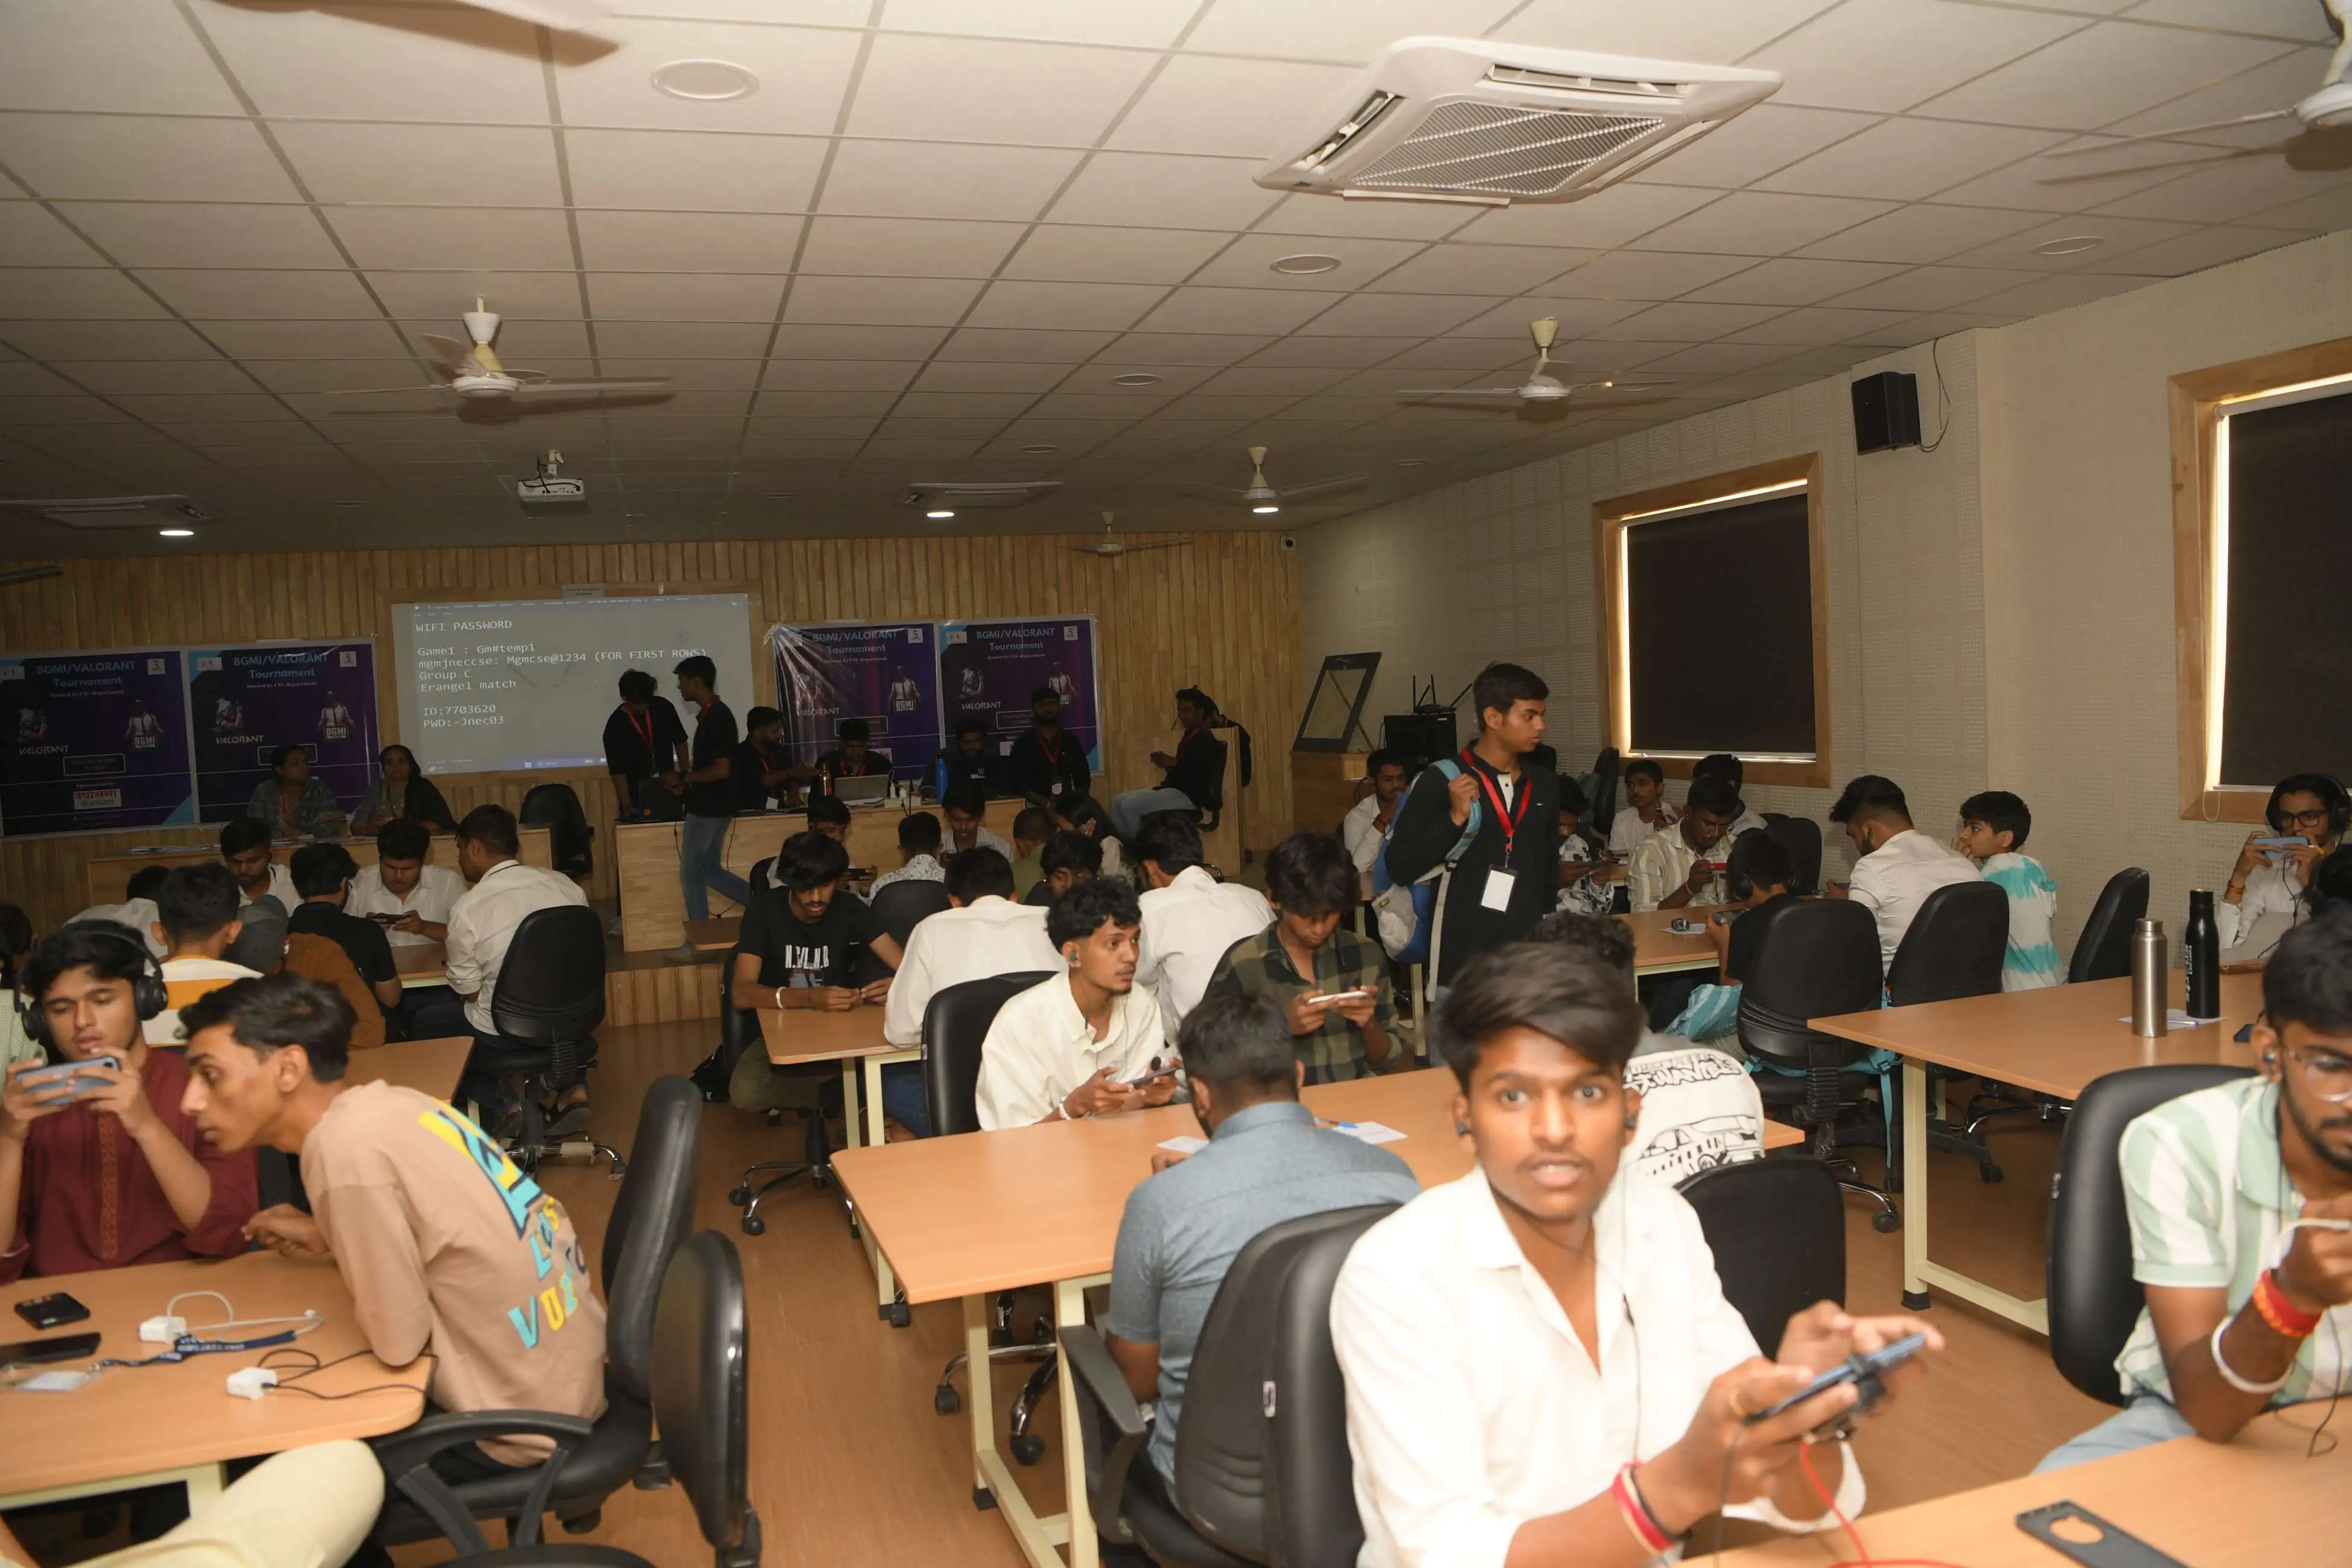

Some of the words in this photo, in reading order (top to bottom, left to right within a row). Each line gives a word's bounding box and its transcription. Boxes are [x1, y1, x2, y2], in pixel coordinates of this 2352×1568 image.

[415, 623, 445, 633] WIFI
[453, 620, 512, 630] PASSWORD
[813, 631, 897, 642] BGMI/VALORANT
[976, 628, 1055, 640] BGMI/VALORANT
[477, 643, 535, 655] Gm#temp1
[827, 644, 886, 655] Tournament
[989, 641, 1044, 651] Tournament
[233, 654, 327, 667] BGMI/VALORANT
[419, 657, 499, 669] mgmjneccse:
[507, 653, 587, 666] Mgmcse@1234
[594, 651, 622, 663] (FOR
[630, 649, 664, 660] FIRST
[36, 660, 136, 675] BGMI/VALORANT
[249, 668, 314, 679] Tournament
[419, 671, 457, 681] Group
[464, 669, 471, 678] C
[53, 676, 122, 687] Tournament
[421, 681, 473, 692] Erangel
[480, 679, 517, 689] match
[896, 700, 914, 708] BGMI
[961, 701, 1001, 710] VALORANT
[422, 704, 496, 716] ID:7703620
[797, 707, 840, 717] VALORANT
[326, 727, 346, 736] BGMI
[134, 736, 156, 745] BGMI
[215, 735, 264, 745] VALORANT
[19, 745, 70, 755] VALORANT
